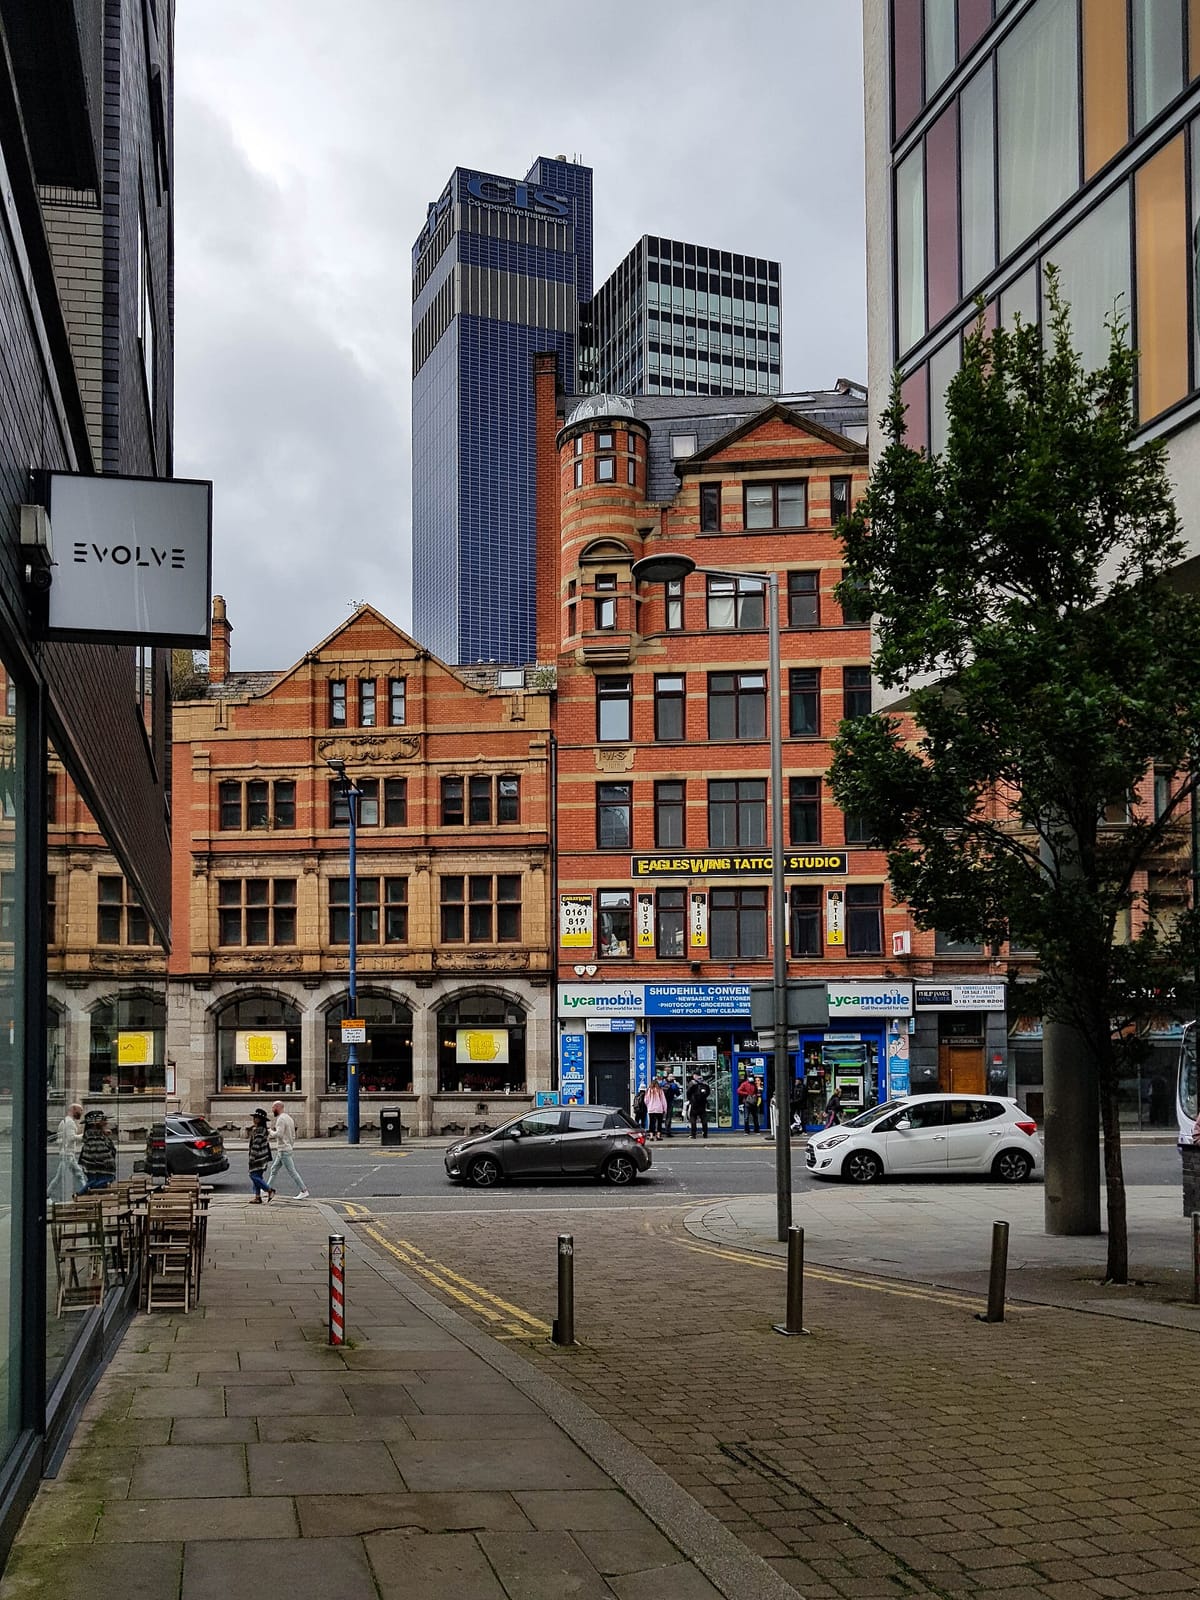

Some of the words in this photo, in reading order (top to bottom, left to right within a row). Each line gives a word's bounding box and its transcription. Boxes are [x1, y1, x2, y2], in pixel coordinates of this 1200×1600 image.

[467, 178, 569, 216] CIS
[467, 198, 525, 216] Co-operative
[524, 209, 569, 226] Insurance
[73, 542, 186, 569] EVOLVE
[733, 857, 788, 869] TATTO
[790, 856, 841, 868] STUDIO
[642, 897, 650, 942] CUSTOM
[695, 895, 703, 945] DESIGNS
[831, 892, 840, 942] ARTISTS
[565, 927, 588, 935] 2111
[563, 993, 643, 1008] Lycamobile
[649, 987, 705, 995] SHUDEHILL
[826, 992, 910, 1007] Lycamobile
